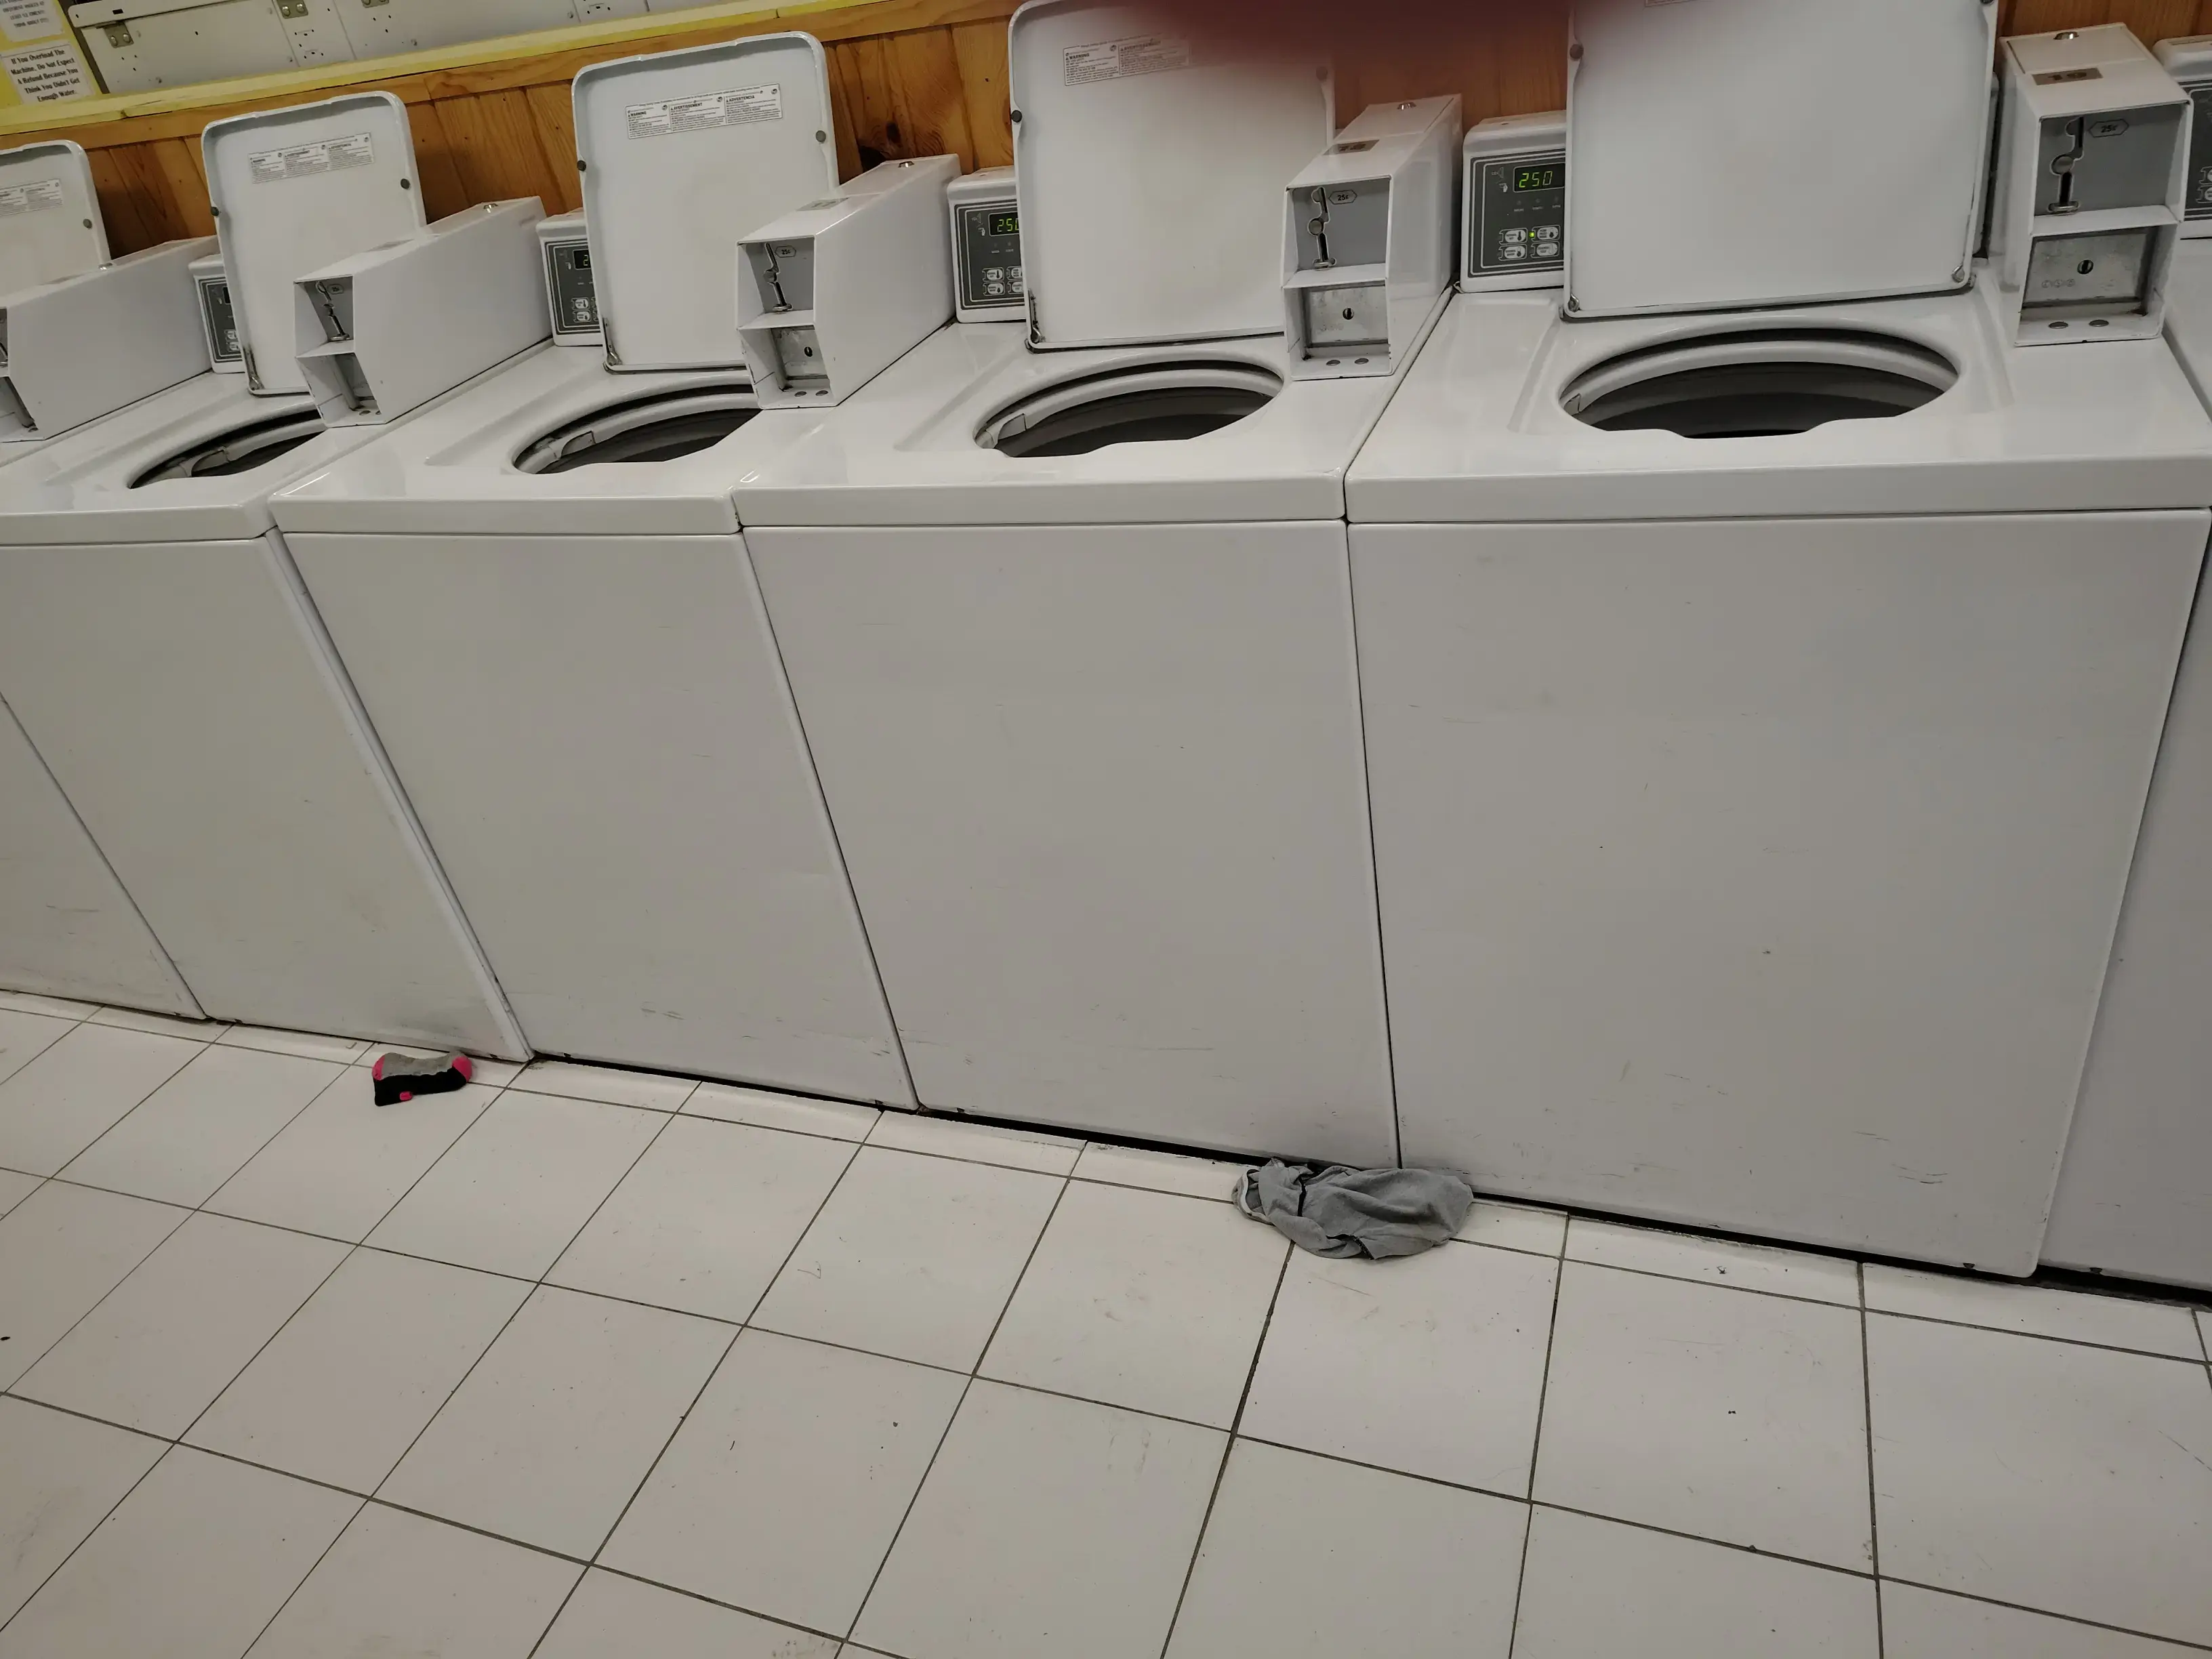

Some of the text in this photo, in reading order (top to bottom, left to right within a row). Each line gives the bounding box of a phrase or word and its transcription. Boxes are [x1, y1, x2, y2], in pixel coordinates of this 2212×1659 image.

[28, 51, 54, 61] Overload
[56, 57, 75, 66] Expect
[22, 75, 43, 84] Refund
[43, 70, 66, 79] Because
[24, 85, 42, 94] Think
[53, 79, 70, 88] Didn't
[37, 92, 59, 102] Enough
[1519, 171, 1553, 188] 250
[583, 254, 589, 266] 2
